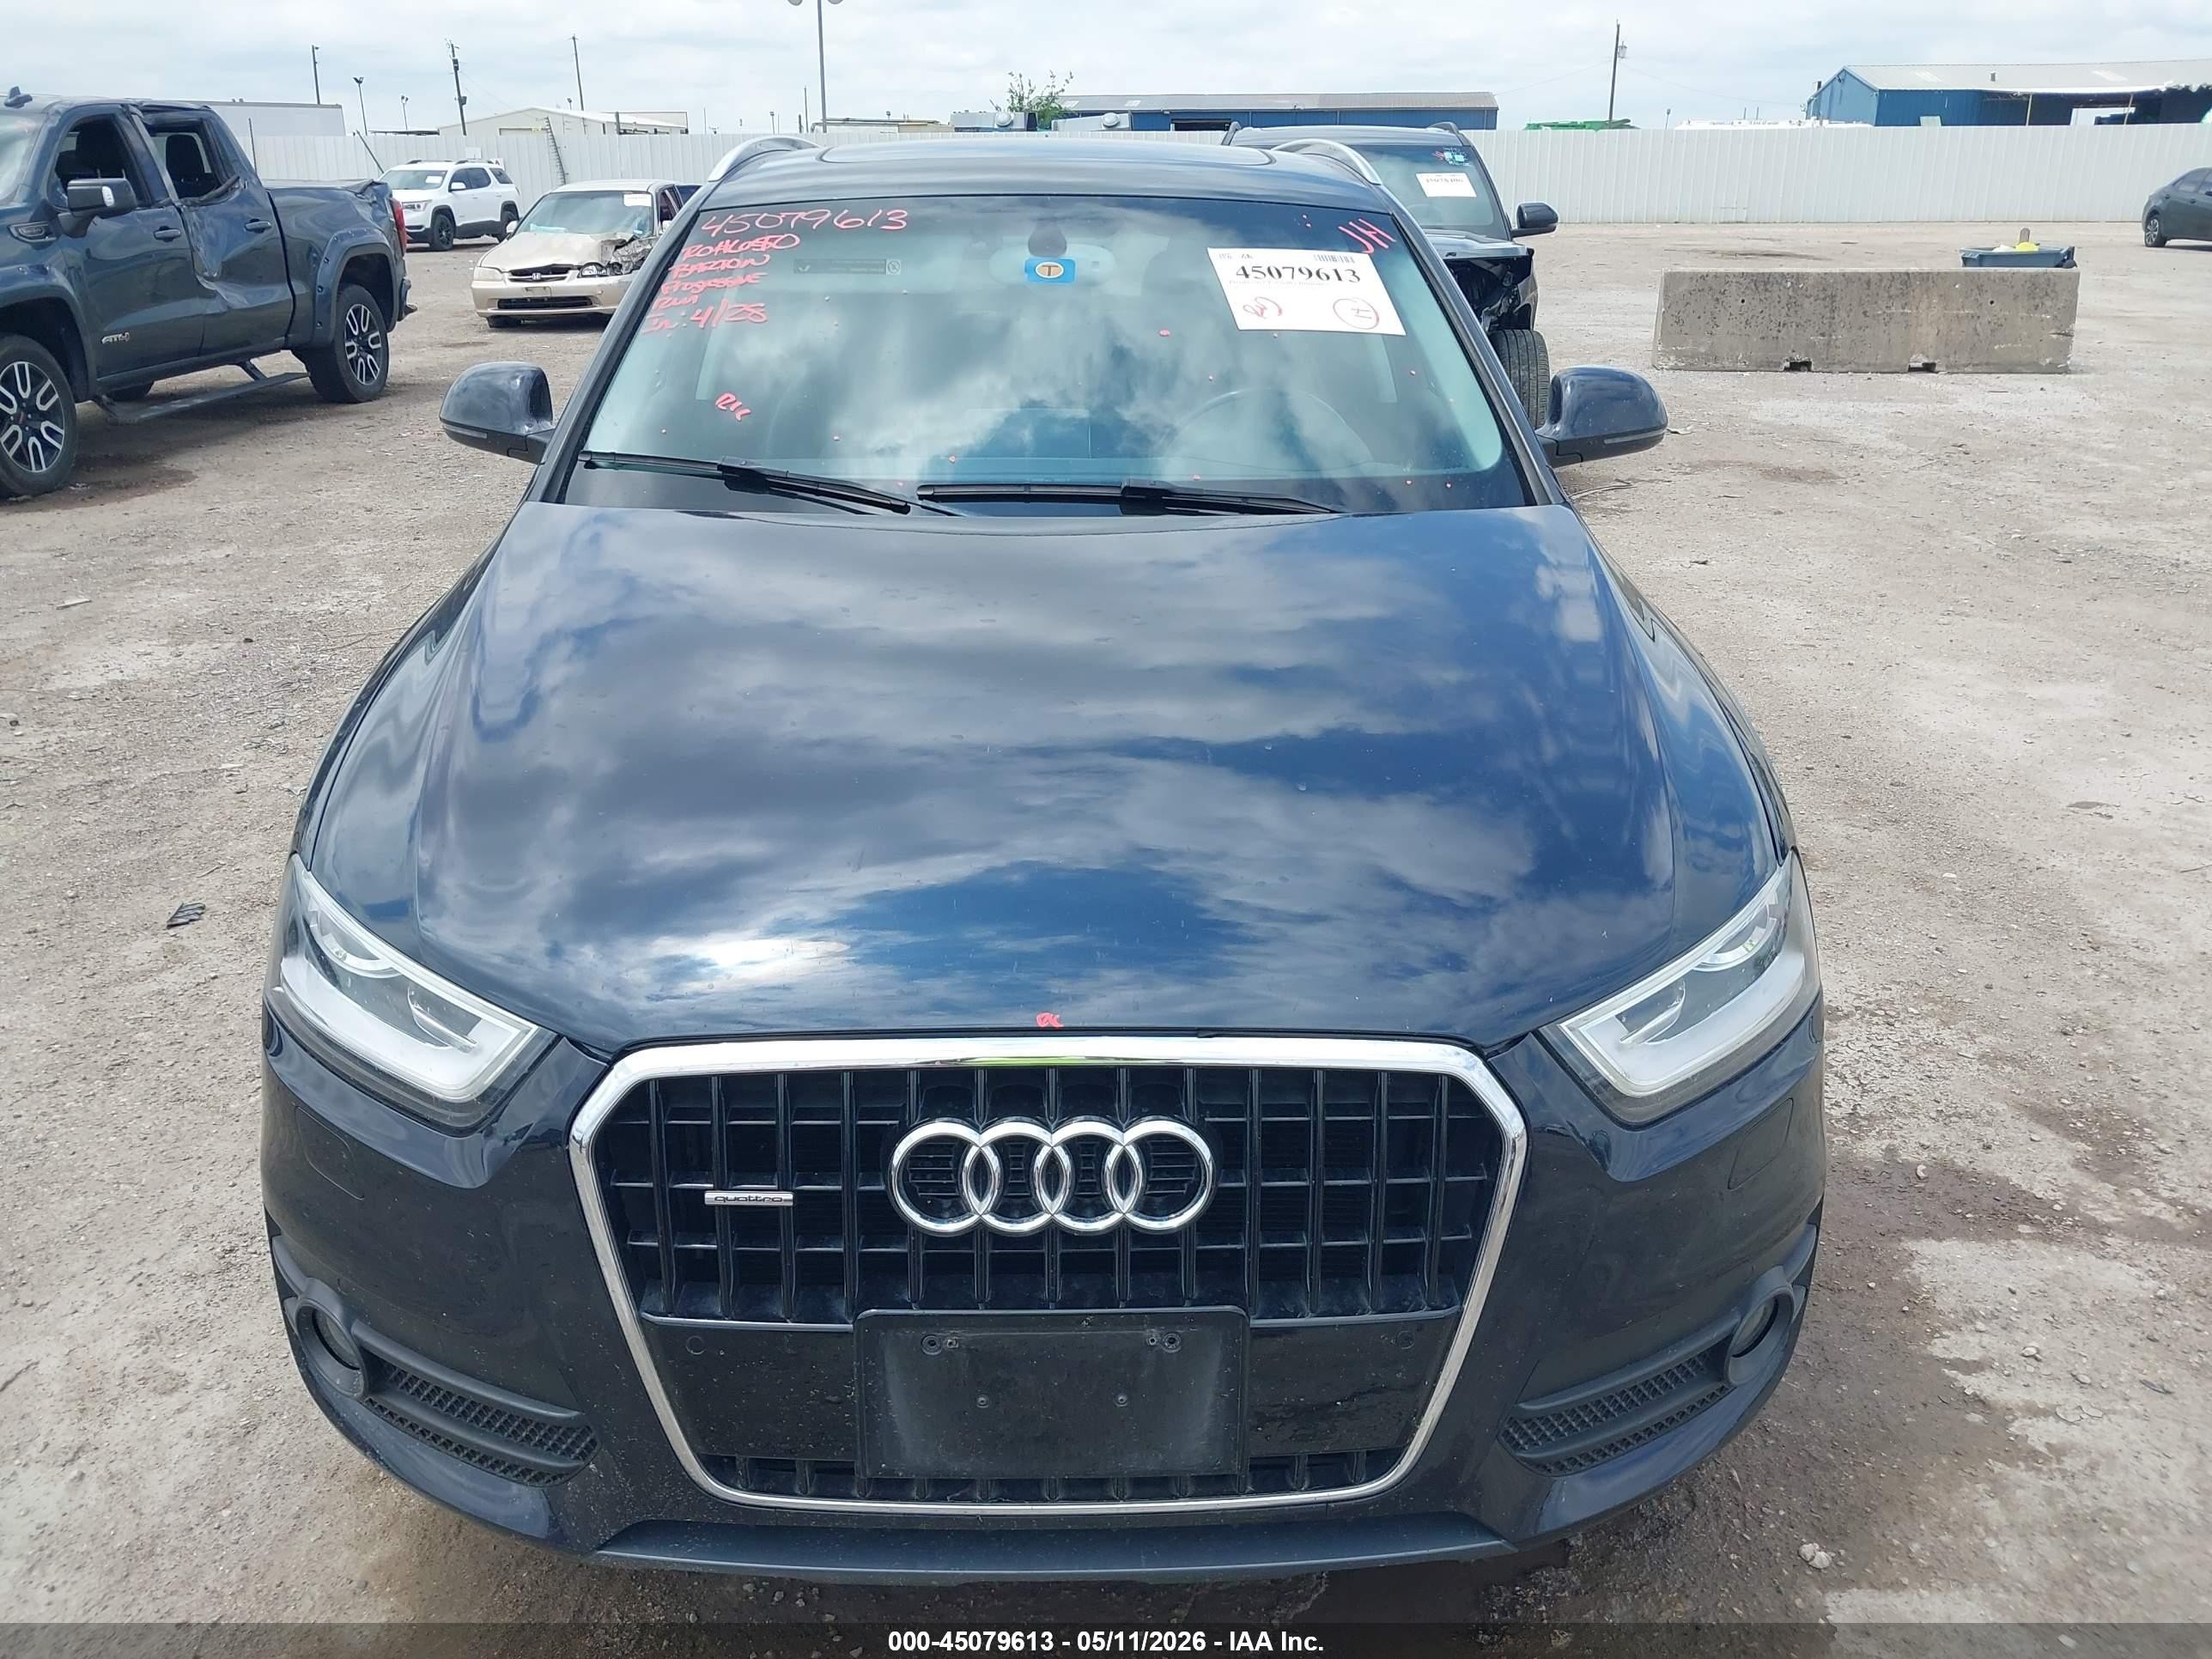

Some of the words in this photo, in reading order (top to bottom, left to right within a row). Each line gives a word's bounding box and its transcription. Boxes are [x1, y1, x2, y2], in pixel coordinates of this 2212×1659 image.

[702, 209, 908, 237] 45079613
[1236, 264, 1361, 283] 45079613
[714, 1194, 783, 1203] quattro
